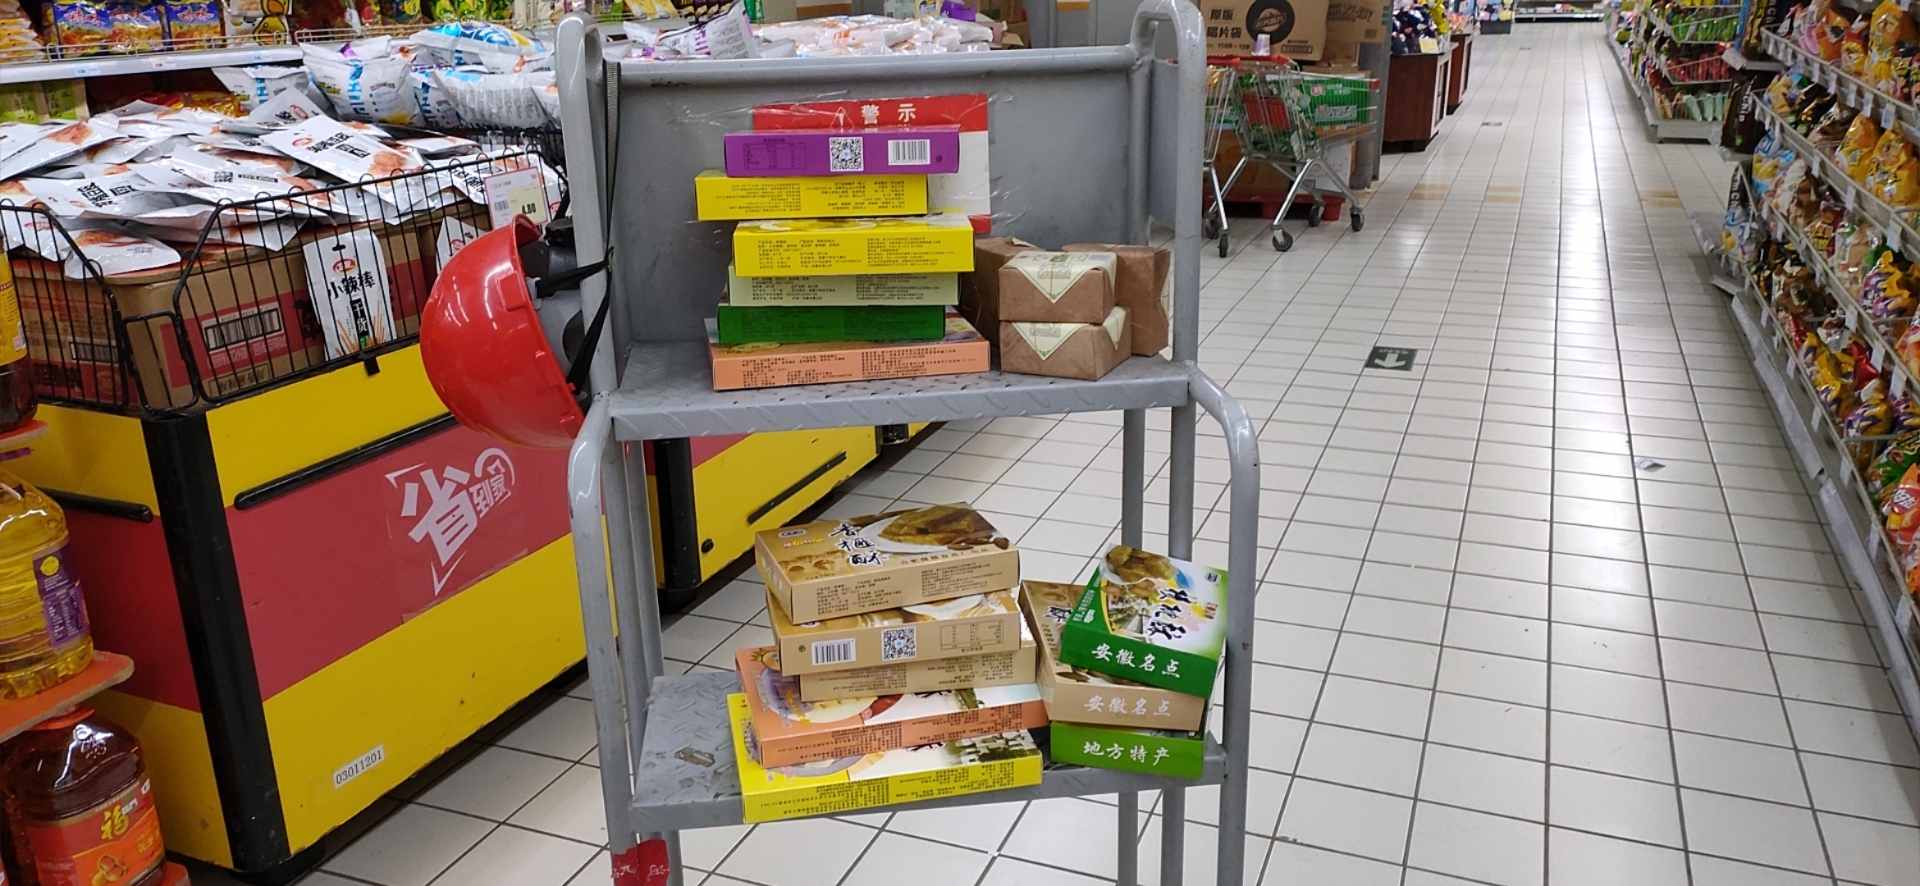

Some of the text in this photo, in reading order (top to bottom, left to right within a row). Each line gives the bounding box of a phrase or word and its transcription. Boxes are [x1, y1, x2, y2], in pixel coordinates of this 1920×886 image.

[1210, 9, 1234, 20] 原版
[1207, 26, 1242, 38] 唱片袋
[861, 103, 917, 125] 警示
[328, 271, 376, 300] 小辣棒
[1091, 642, 1182, 679] 安徽名点
[1083, 694, 1172, 717] 安徽名点
[1083, 740, 1171, 767] 地方特产
[335, 749, 382, 785] 03011201
